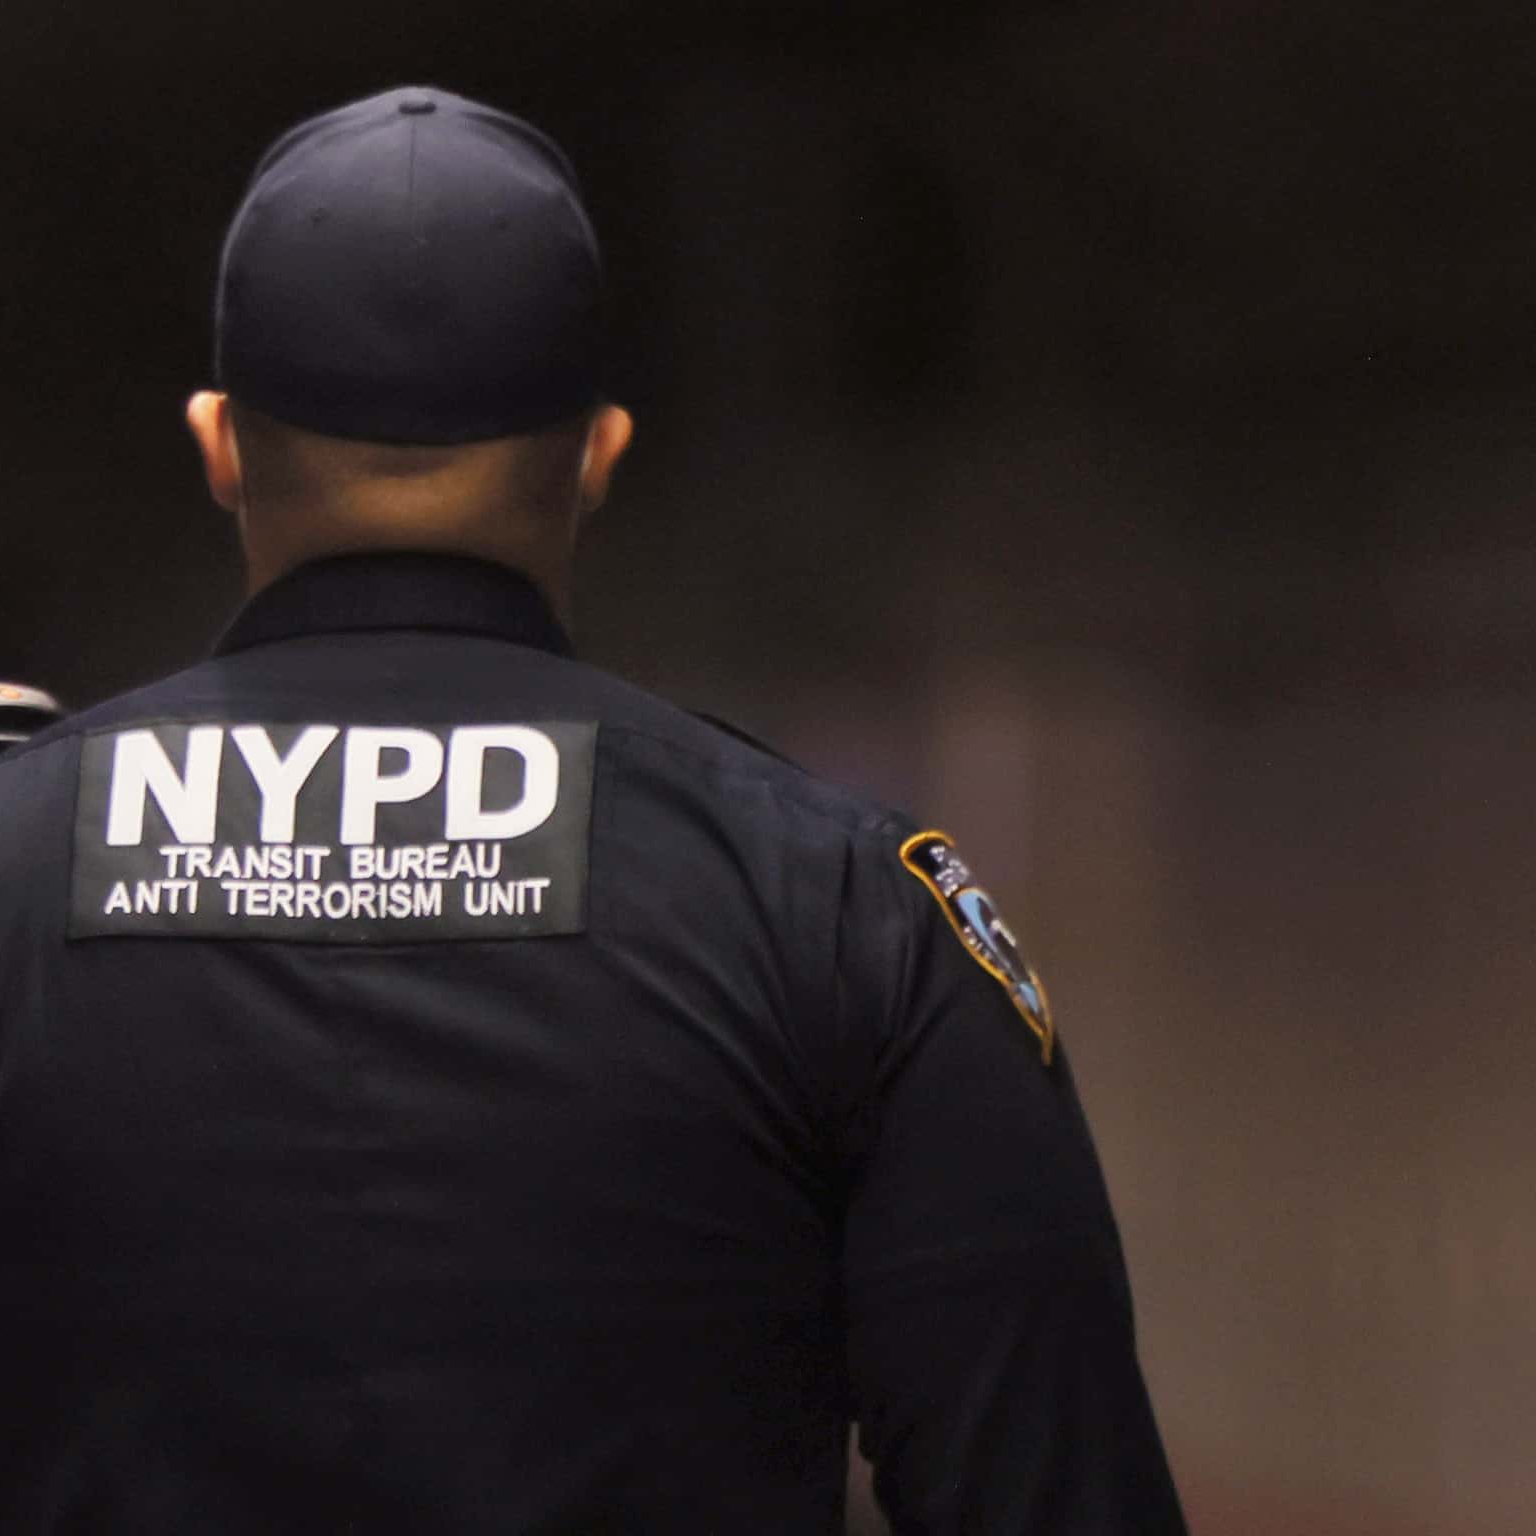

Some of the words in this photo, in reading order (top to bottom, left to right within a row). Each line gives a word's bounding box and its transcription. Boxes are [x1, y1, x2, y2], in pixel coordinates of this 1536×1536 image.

[106, 724, 560, 846] NYPD
[160, 845, 330, 881] TRANSIT
[350, 844, 501, 880] BUREAU
[104, 879, 199, 915] ANTI
[220, 881, 442, 919] TERRORISM
[464, 878, 550, 917] UNIT
